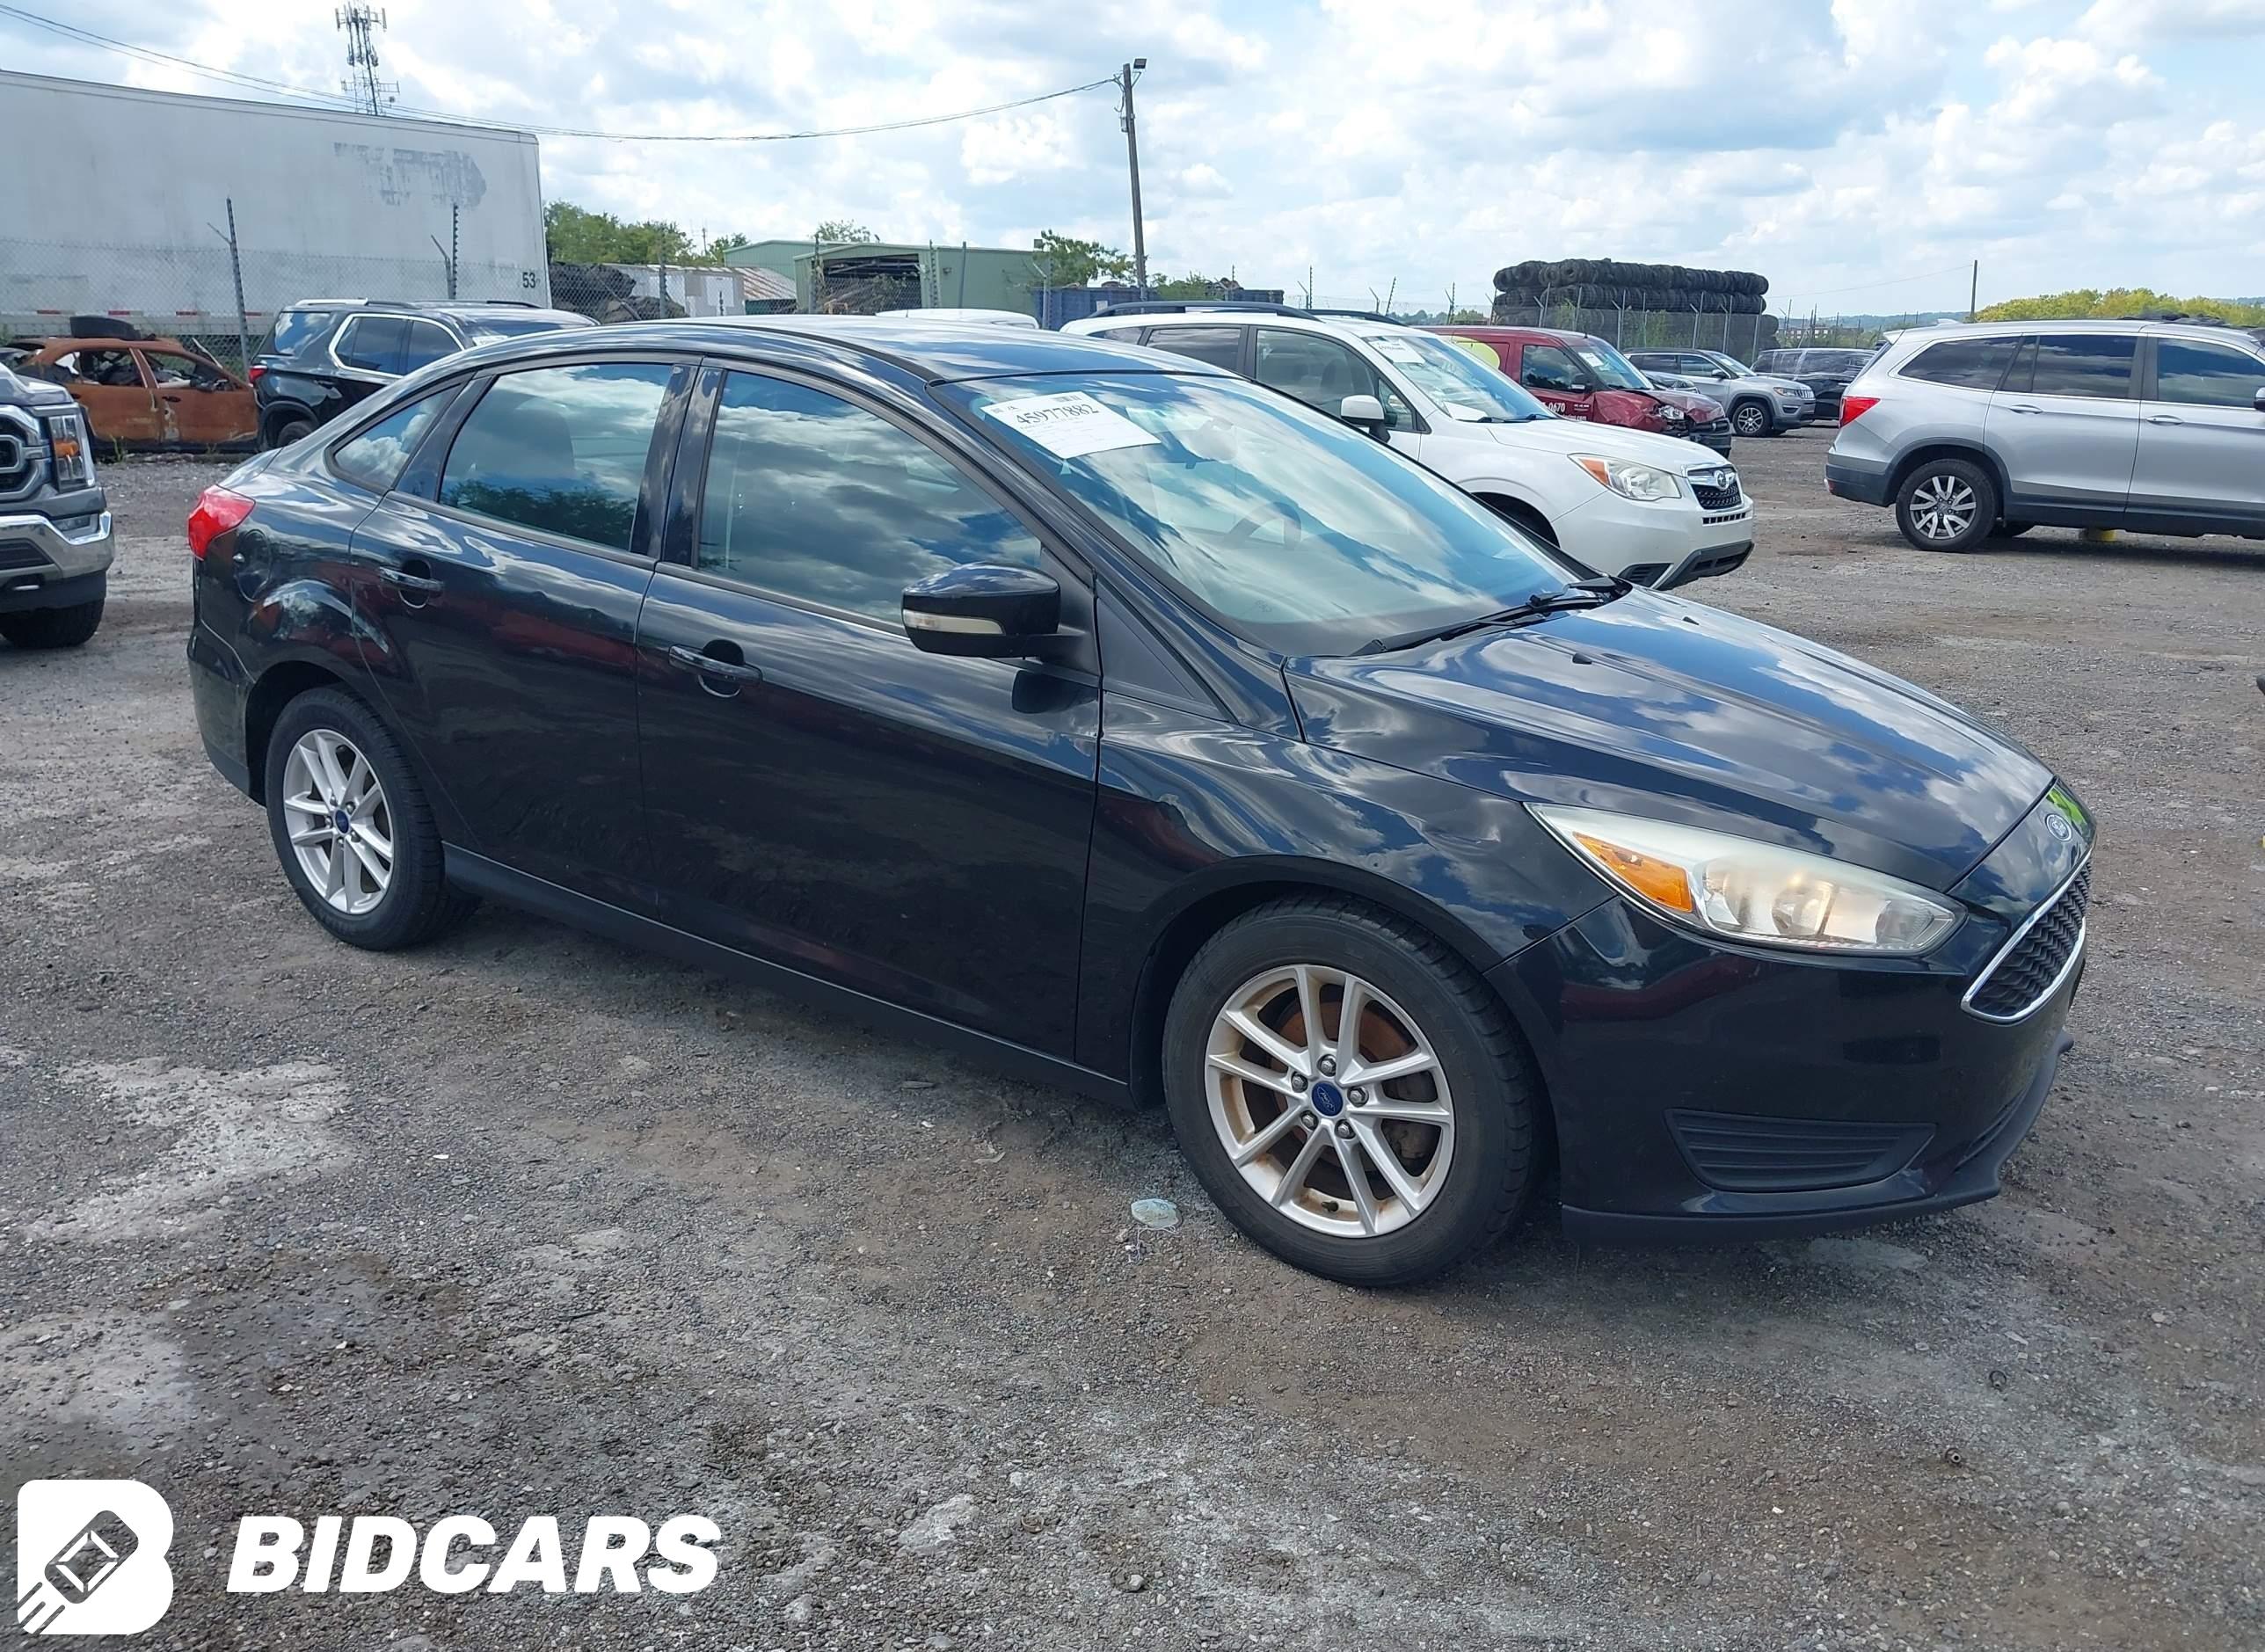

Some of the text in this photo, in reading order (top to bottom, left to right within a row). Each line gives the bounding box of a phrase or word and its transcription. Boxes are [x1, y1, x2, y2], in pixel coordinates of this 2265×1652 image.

[522, 272, 536, 288] 53
[1016, 404, 1100, 424] 45977882
[1542, 402, 1566, 413] 0670
